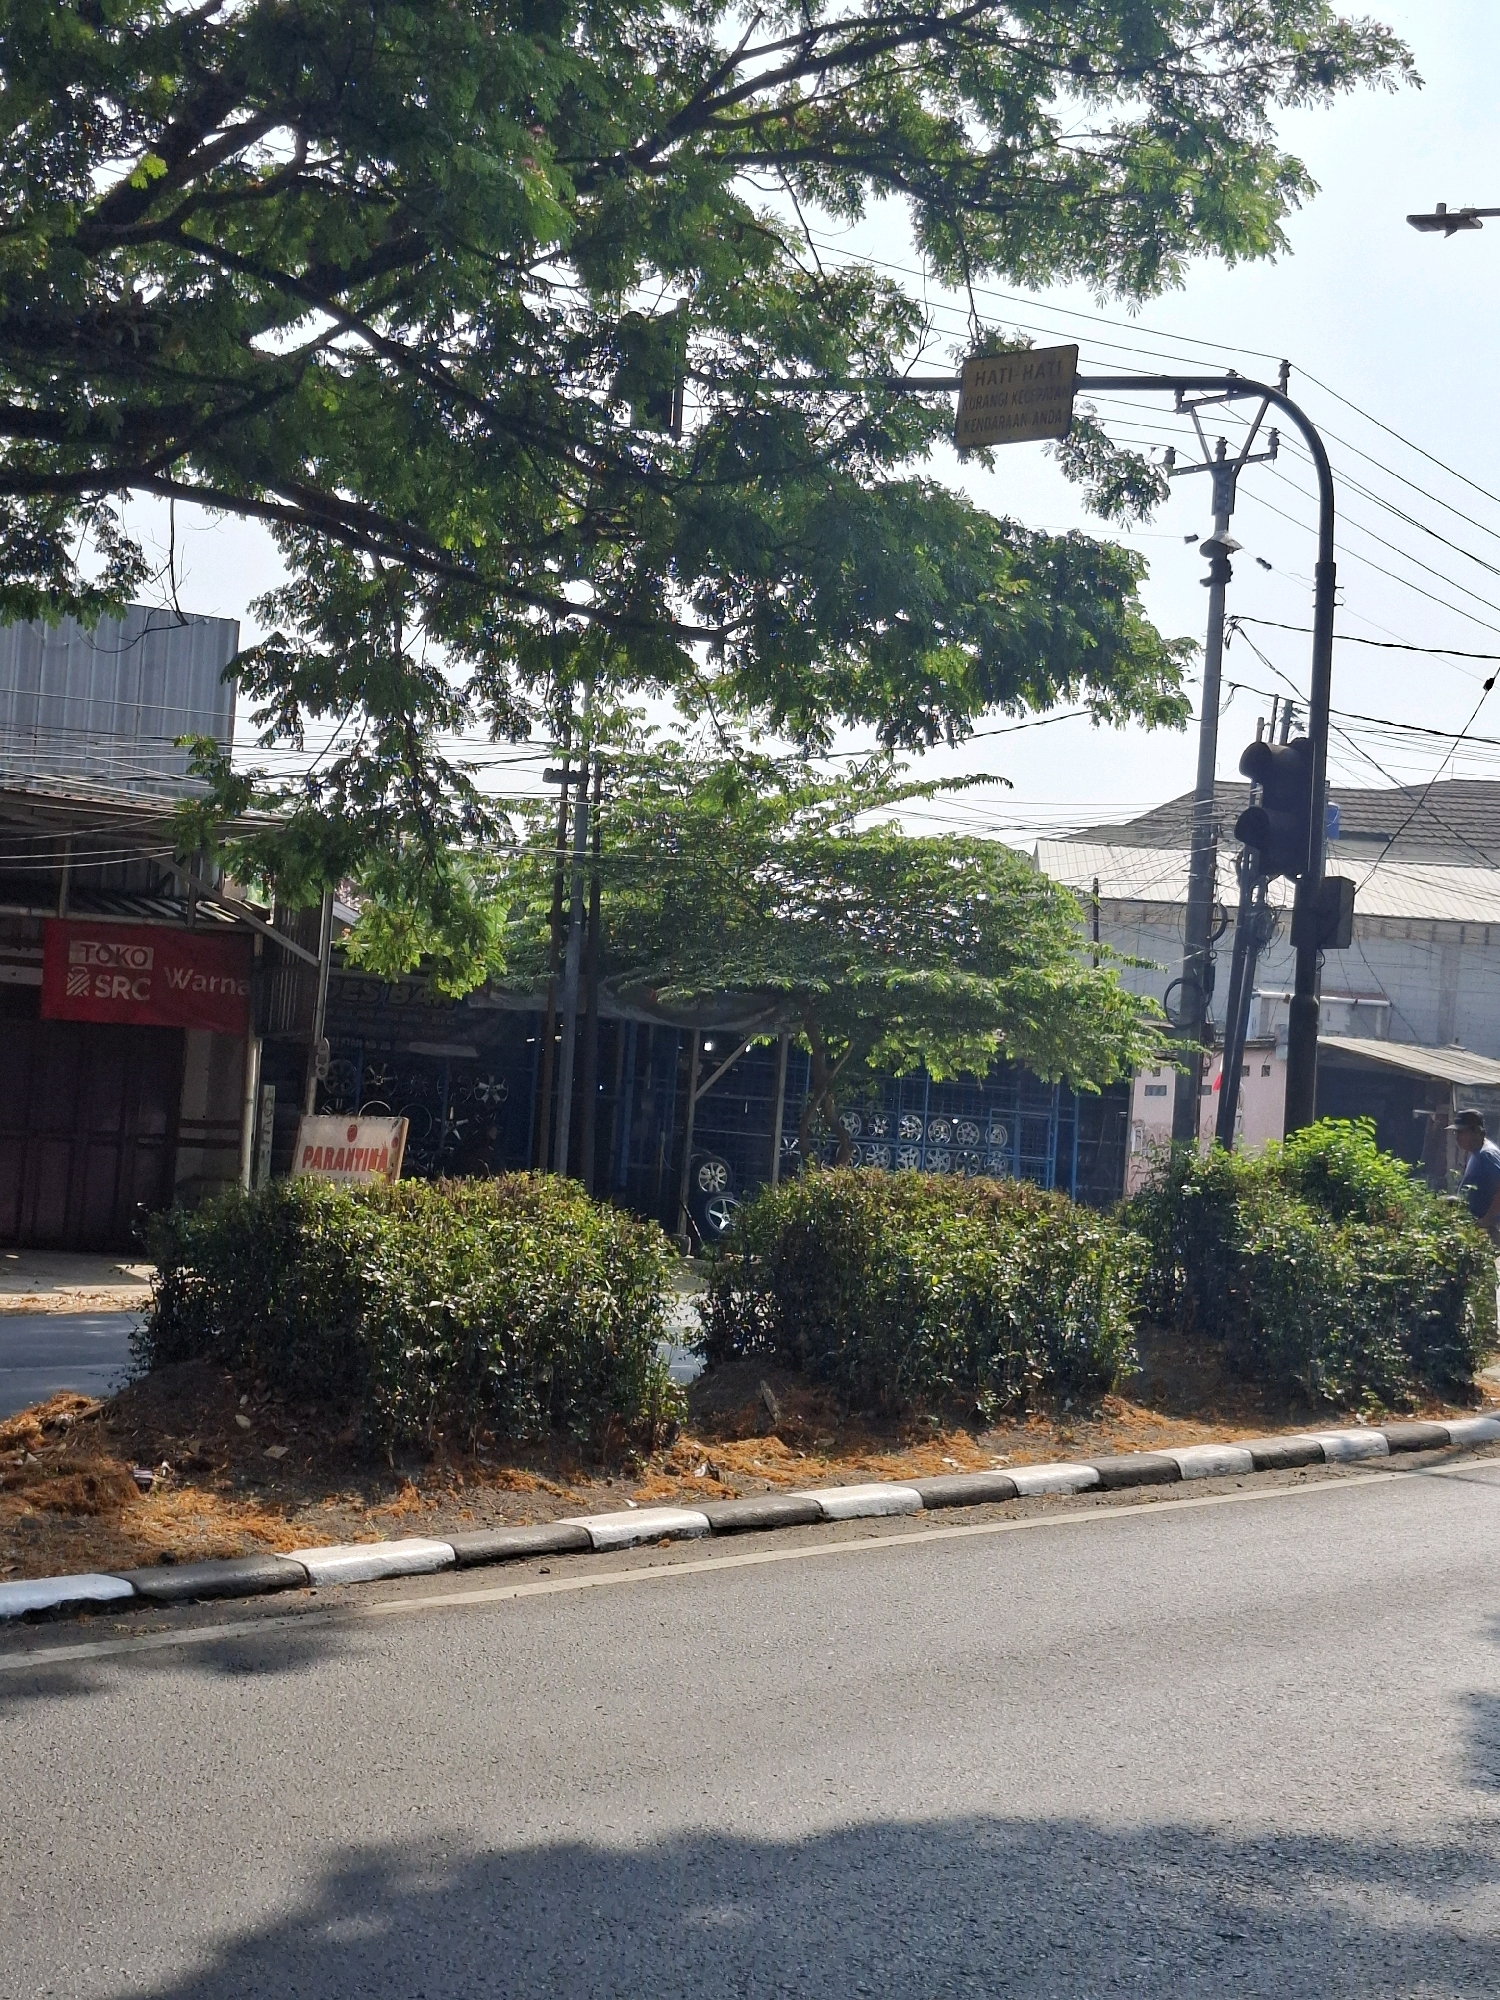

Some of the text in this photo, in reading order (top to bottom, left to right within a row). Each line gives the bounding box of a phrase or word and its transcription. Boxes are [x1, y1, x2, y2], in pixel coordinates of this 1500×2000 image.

[1032, 409, 1062, 426] ANDA
[80, 943, 149, 967] TOKO
[94, 974, 152, 1001] SRC
